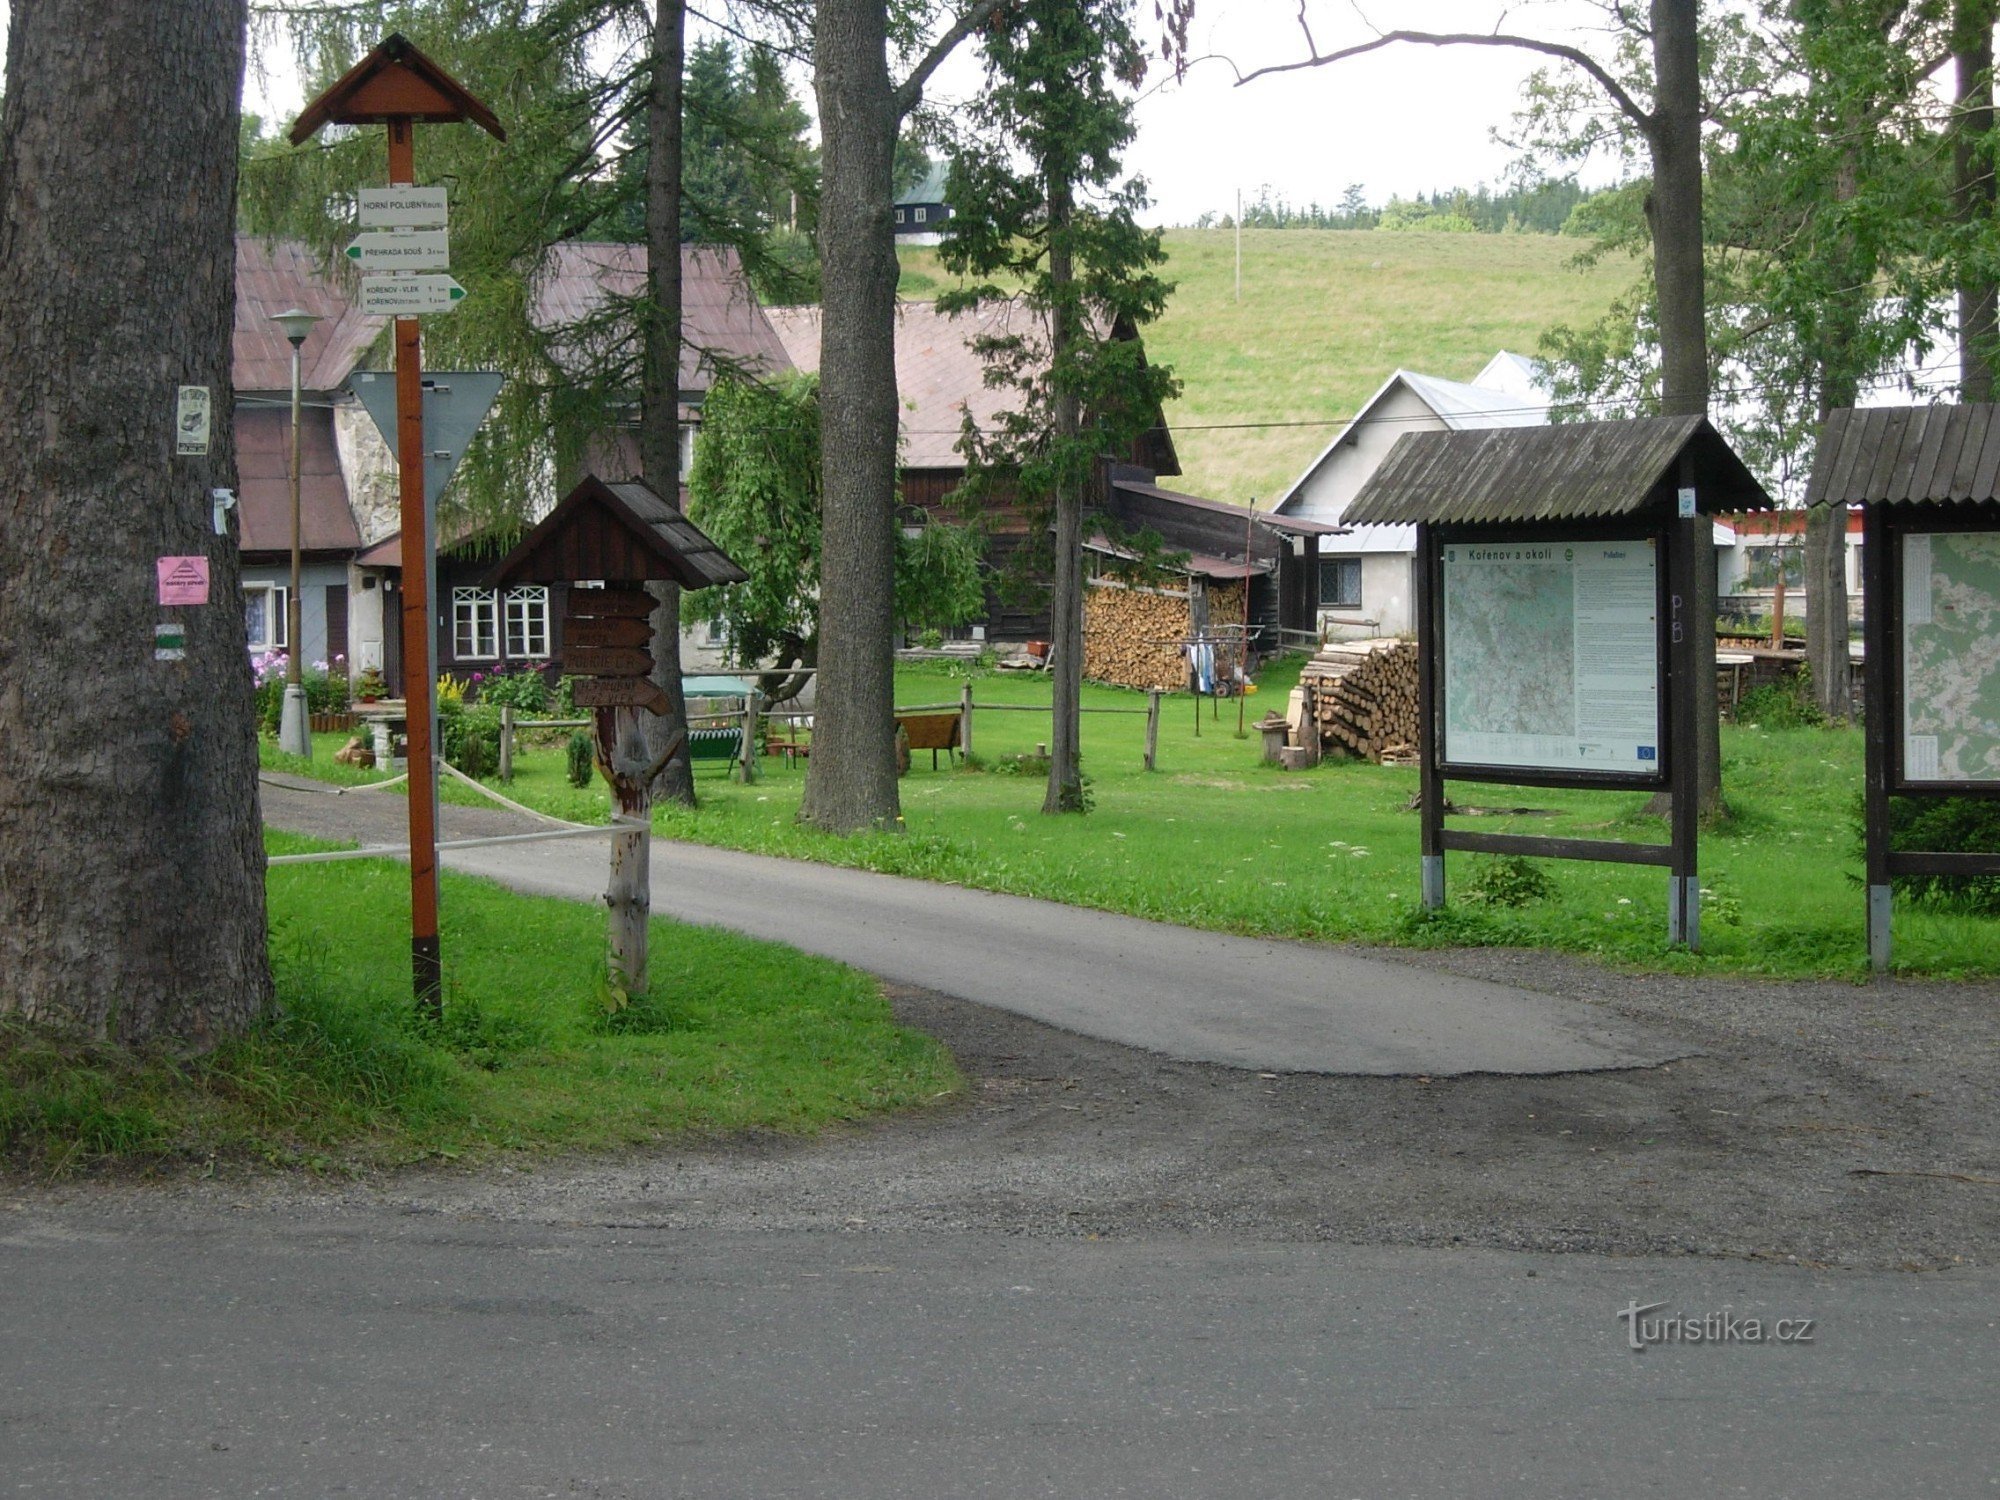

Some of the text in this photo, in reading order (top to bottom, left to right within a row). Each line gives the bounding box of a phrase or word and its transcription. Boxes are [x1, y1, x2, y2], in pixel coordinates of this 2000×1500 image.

[363, 200, 388, 210] HORNÍ
[365, 247, 402, 256] PŘEHRADA
[403, 247, 423, 256] SOUŠ
[366, 285, 397, 293] KOŘENOV
[403, 285, 419, 293] VLEK
[366, 297, 397, 305] KOŘENOV
[1468, 548, 1552, 560] Kořenov a okolí
